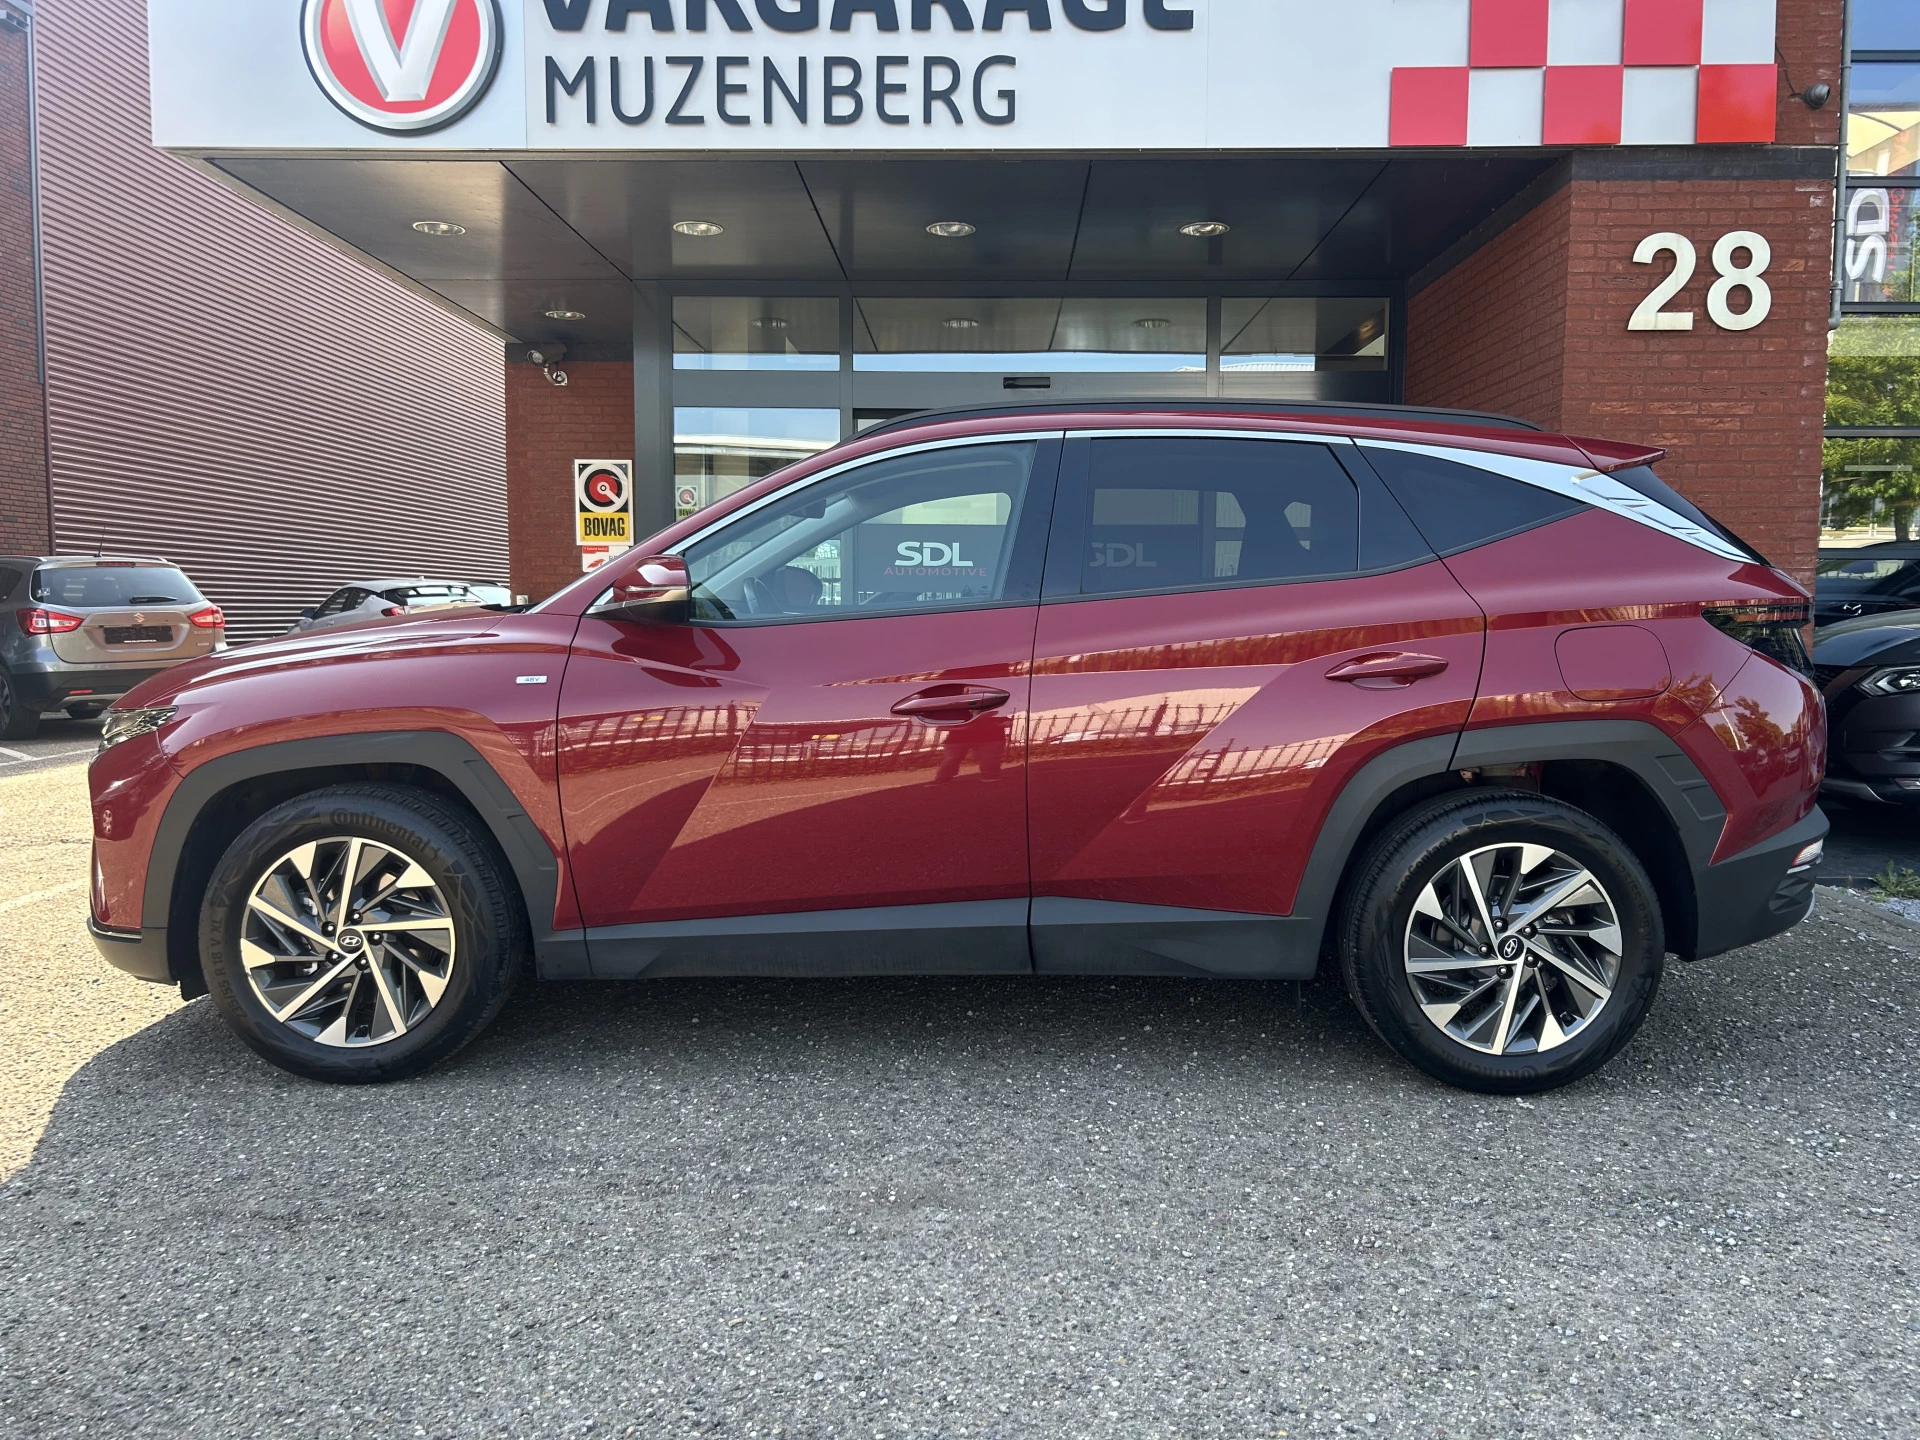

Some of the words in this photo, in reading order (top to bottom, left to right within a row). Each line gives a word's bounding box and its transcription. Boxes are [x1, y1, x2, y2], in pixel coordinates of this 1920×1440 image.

[545, 55, 1017, 124] MUZENBERG
[1627, 231, 1772, 331] 28
[584, 517, 625, 537] BOVAG
[884, 566, 988, 577] AUTOMOTIVE
[894, 541, 974, 567] SDL
[330, 808, 431, 853] Continental
